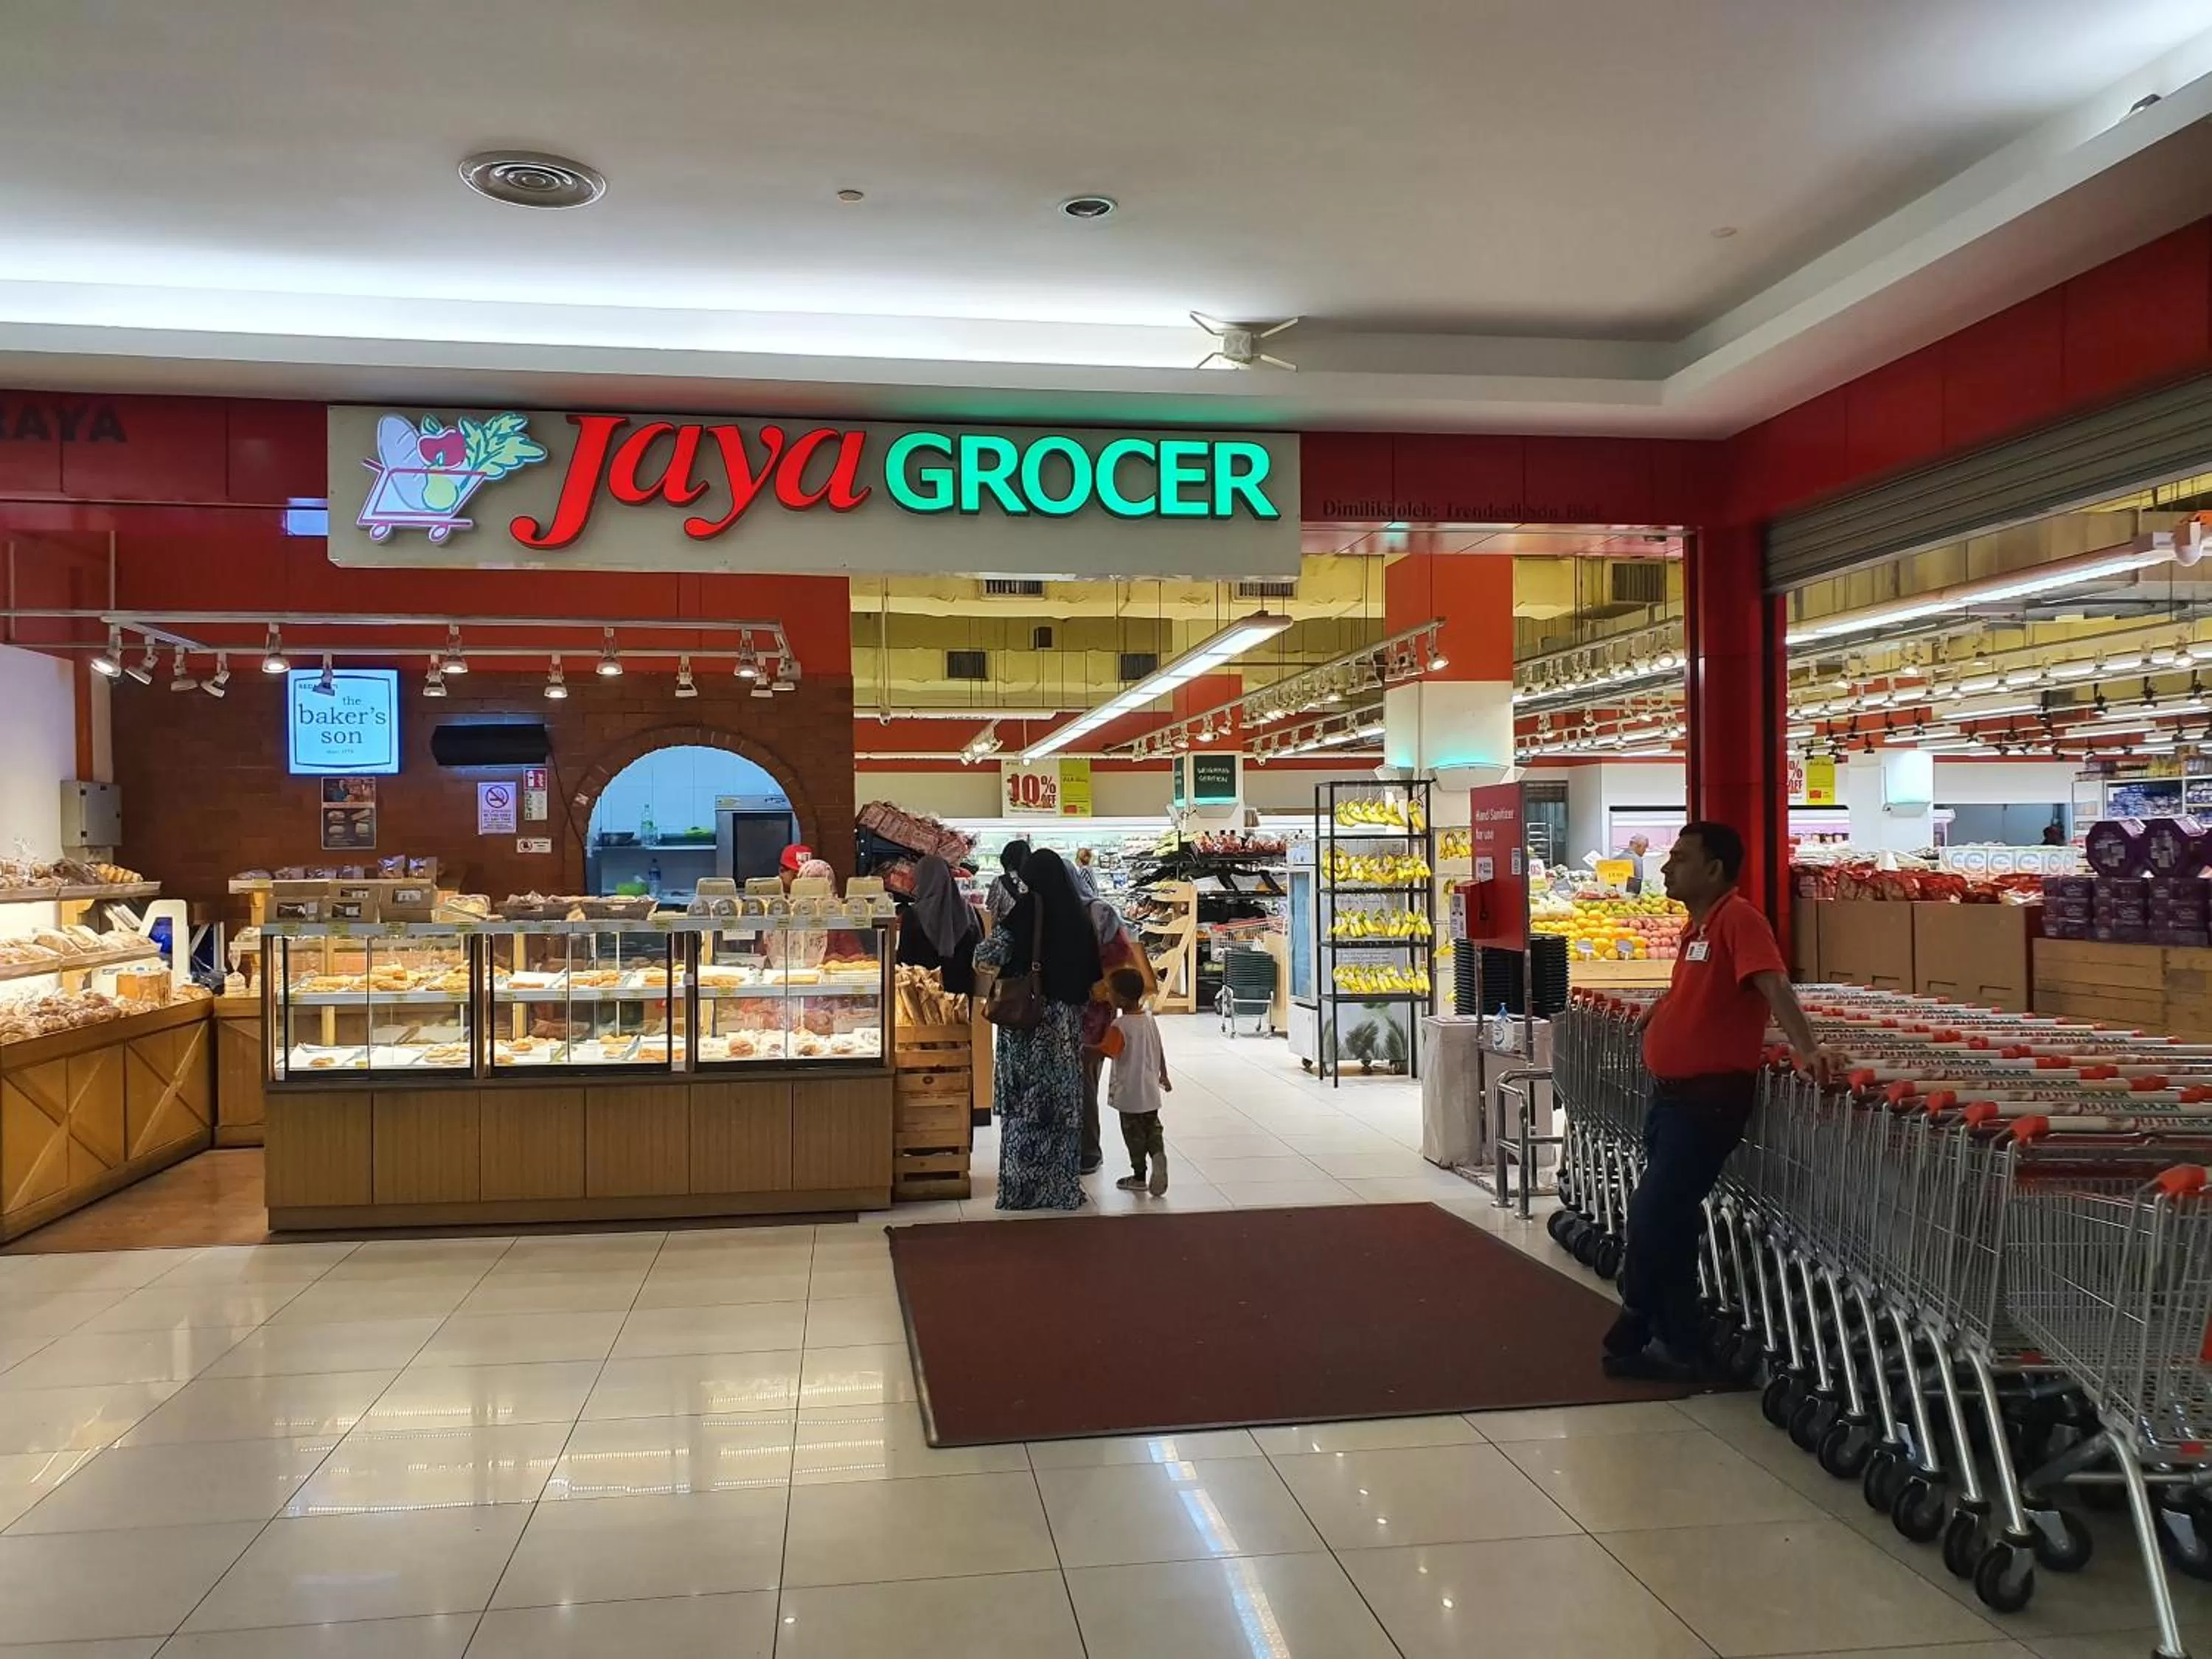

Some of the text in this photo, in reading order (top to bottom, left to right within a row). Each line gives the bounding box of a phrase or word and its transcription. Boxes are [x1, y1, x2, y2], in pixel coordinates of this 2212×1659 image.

[0, 403, 128, 443] AYA
[509, 414, 1281, 550] Jaya GROCER
[1322, 499, 1393, 517] Dimiliki
[342, 696, 361, 705] the
[299, 703, 386, 725] baker's
[321, 731, 362, 743] son
